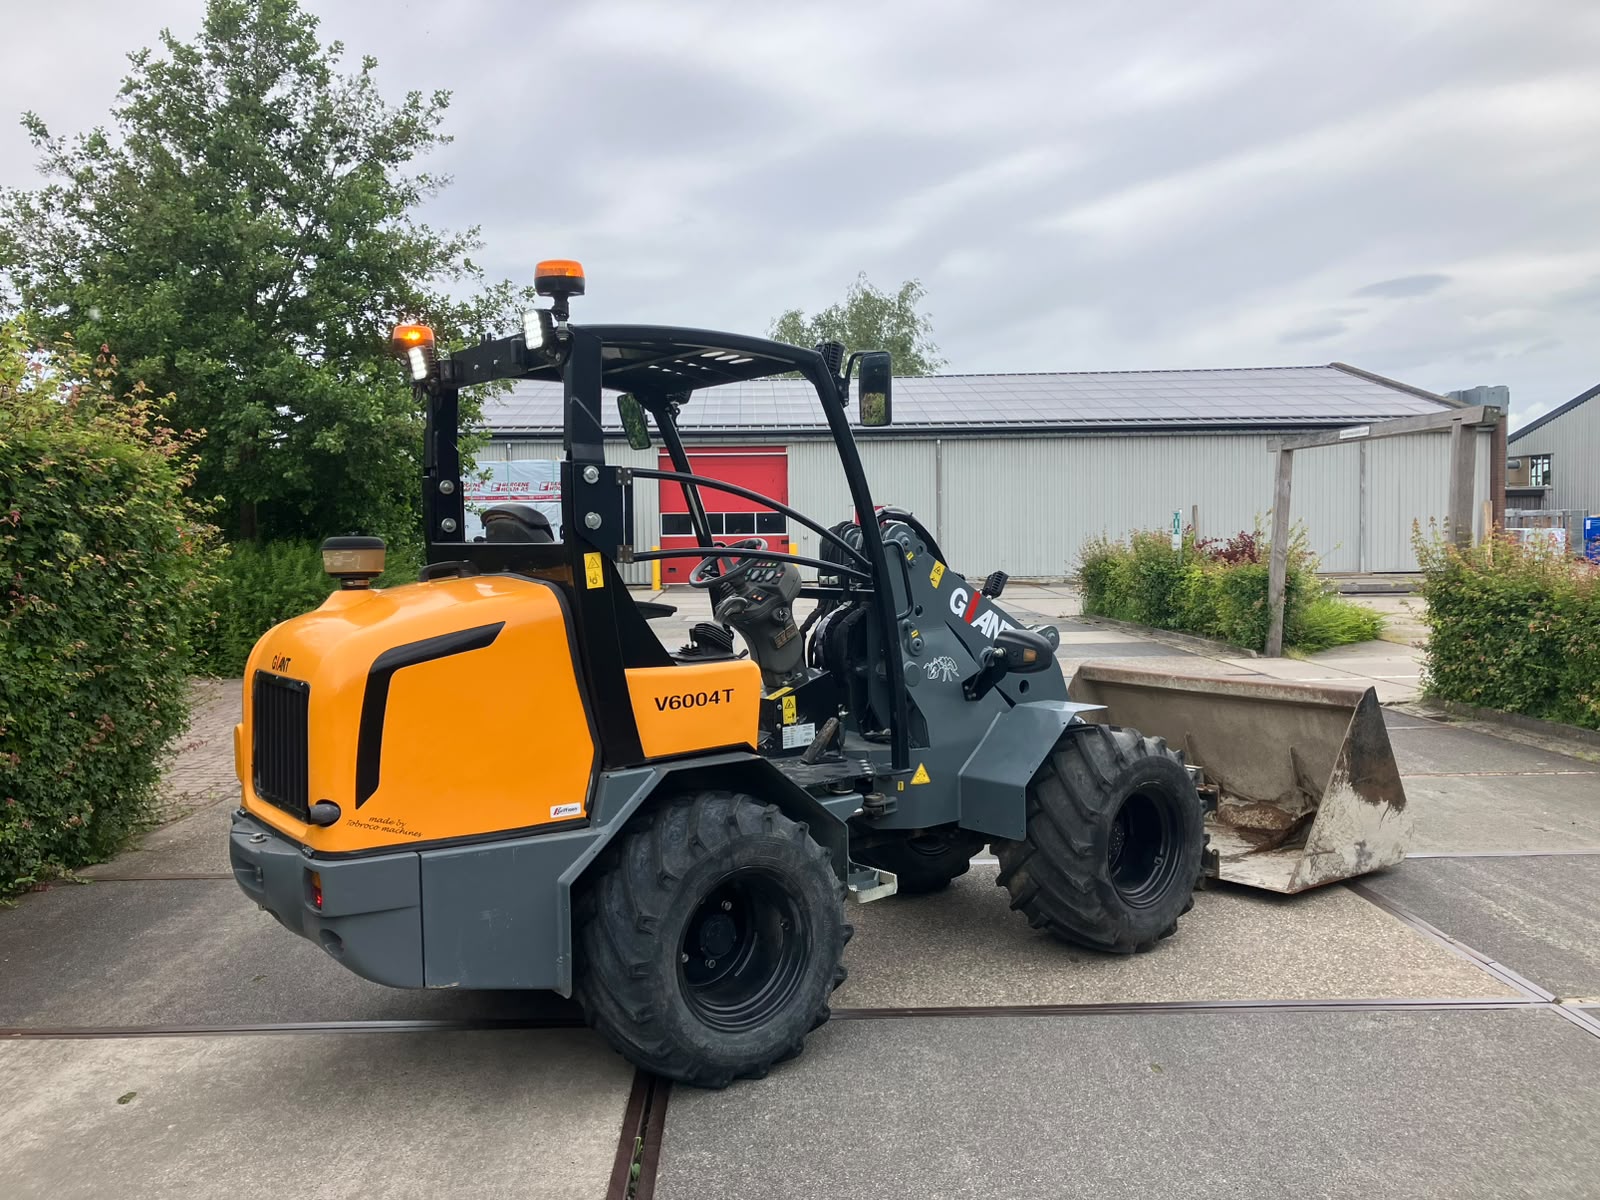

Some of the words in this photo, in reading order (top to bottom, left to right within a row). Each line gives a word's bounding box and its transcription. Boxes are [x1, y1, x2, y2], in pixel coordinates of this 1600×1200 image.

[654, 688, 735, 711] V6004T
[346, 819, 380, 831] Tobroco
[381, 827, 423, 837] machines
[368, 816, 395, 825] made
[396, 819, 407, 828] by
